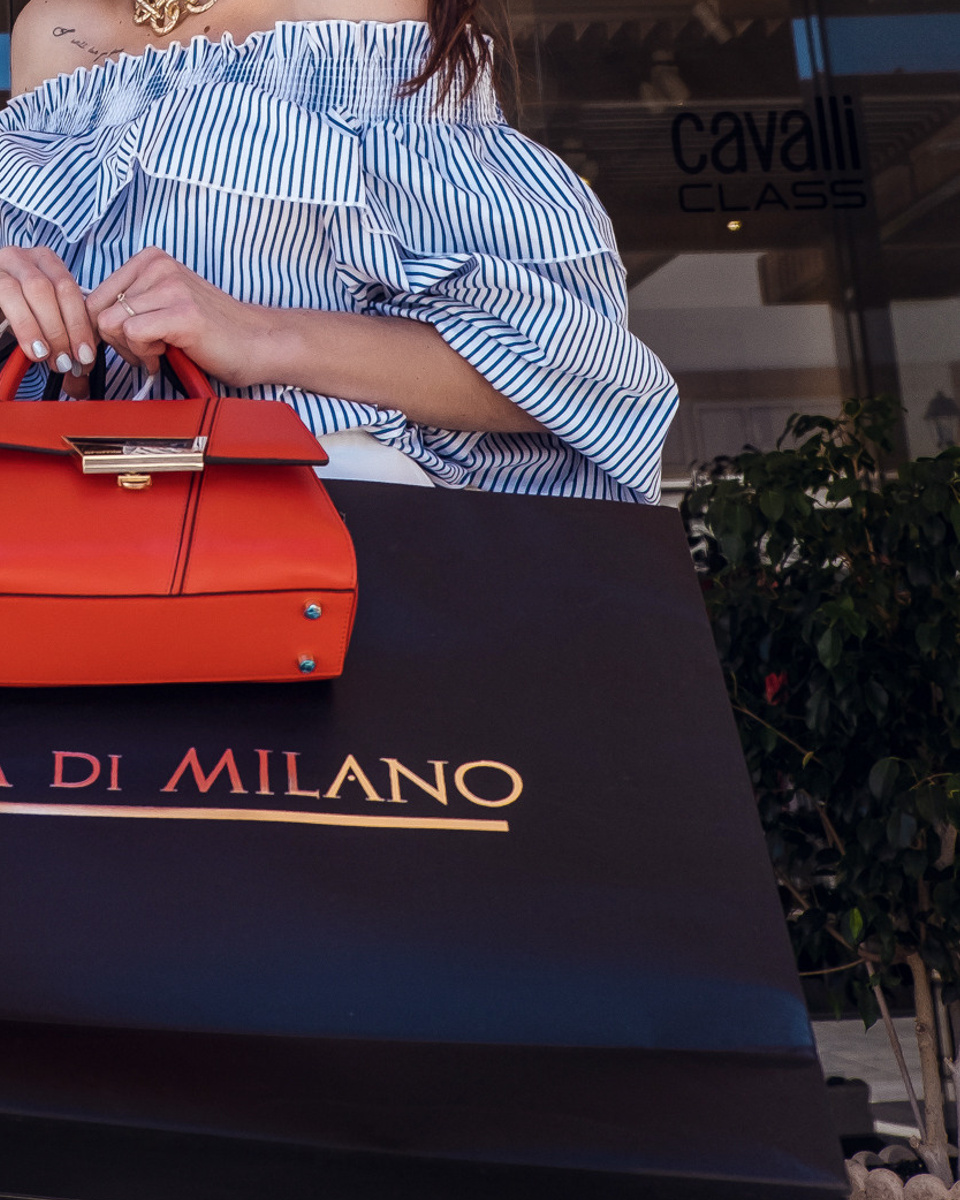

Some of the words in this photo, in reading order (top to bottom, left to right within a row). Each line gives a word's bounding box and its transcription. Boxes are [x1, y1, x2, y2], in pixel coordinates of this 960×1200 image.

[671, 96, 860, 175] cavalli
[678, 179, 867, 213] CLASS
[49, 750, 122, 791] DI
[160, 746, 524, 808] MILANO
